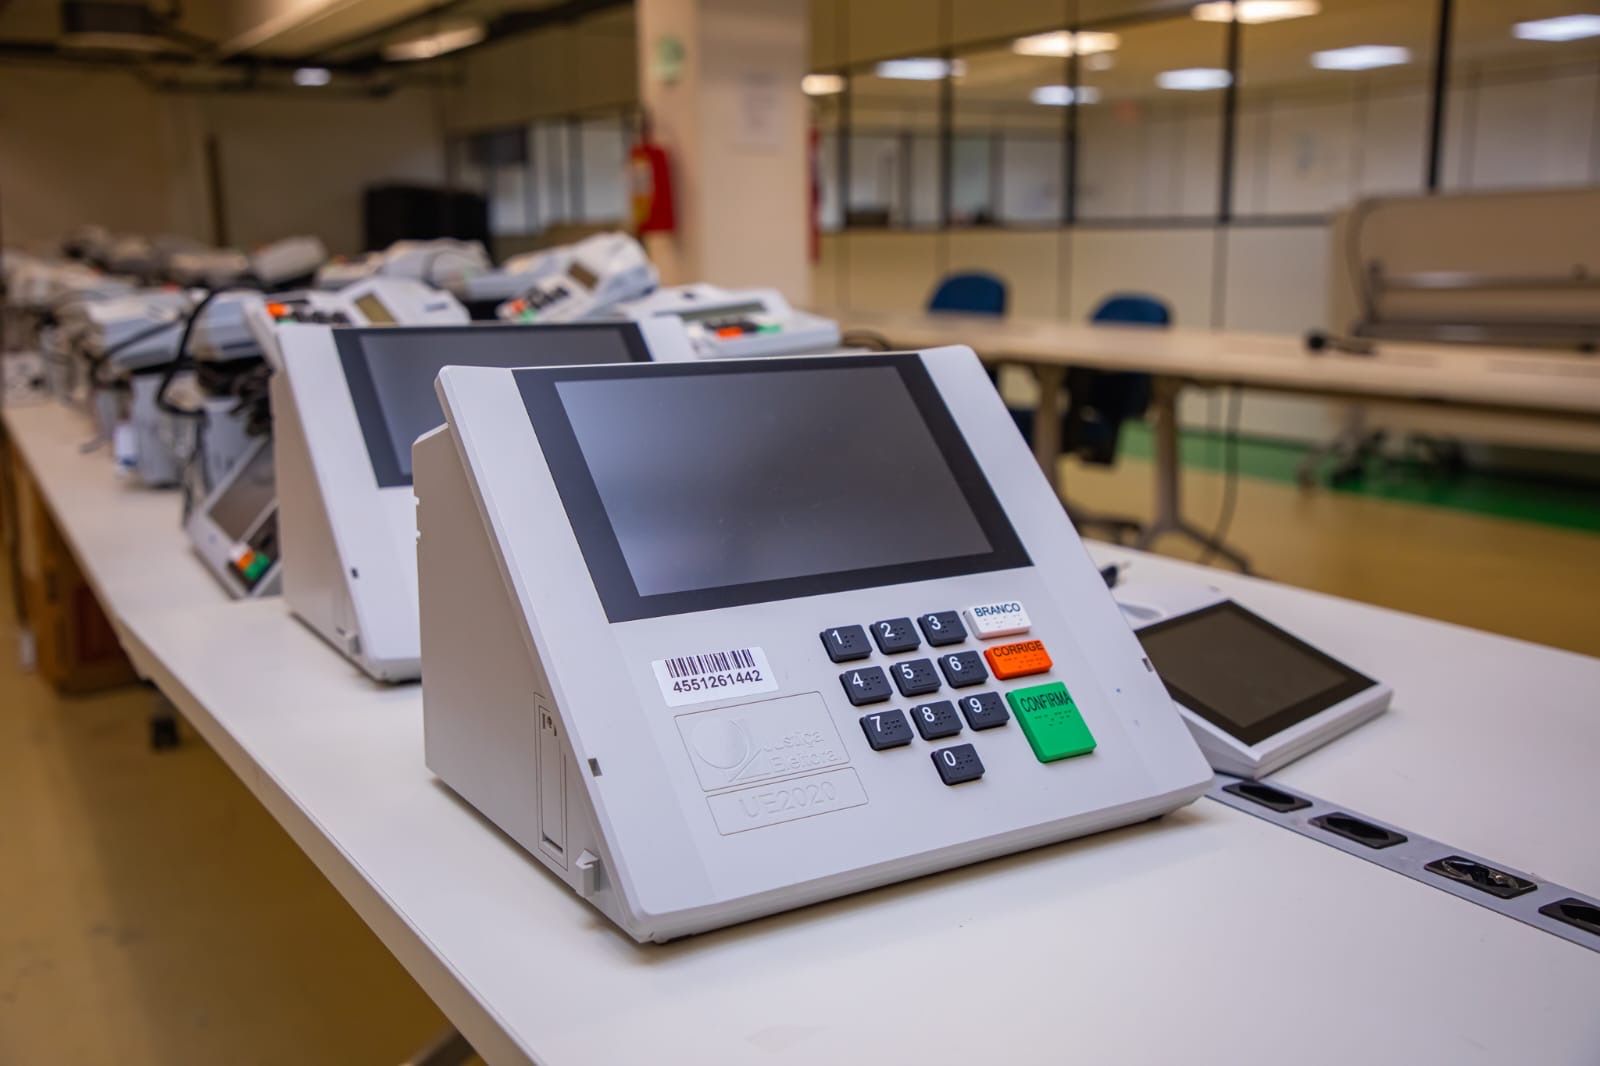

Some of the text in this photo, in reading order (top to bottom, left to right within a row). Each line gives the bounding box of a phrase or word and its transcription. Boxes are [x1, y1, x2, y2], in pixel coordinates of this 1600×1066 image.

[974, 603, 1021, 617] BRANCO
[880, 623, 895, 638] 2
[928, 616, 942, 631] 3
[832, 630, 843, 645] 1
[992, 640, 1044, 657] CORRIGE
[901, 664, 914, 679] 5
[949, 656, 962, 672] 6
[673, 670, 763, 693] 4551261442
[852, 672, 864, 688] 4
[969, 698, 982, 713] 9
[1020, 690, 1073, 712] CONFIRMA
[922, 707, 935, 722] 8
[870, 716, 881, 733] 7
[769, 748, 841, 773] Eeitora
[943, 751, 957, 767] 0
[739, 781, 836, 818] UE2020
